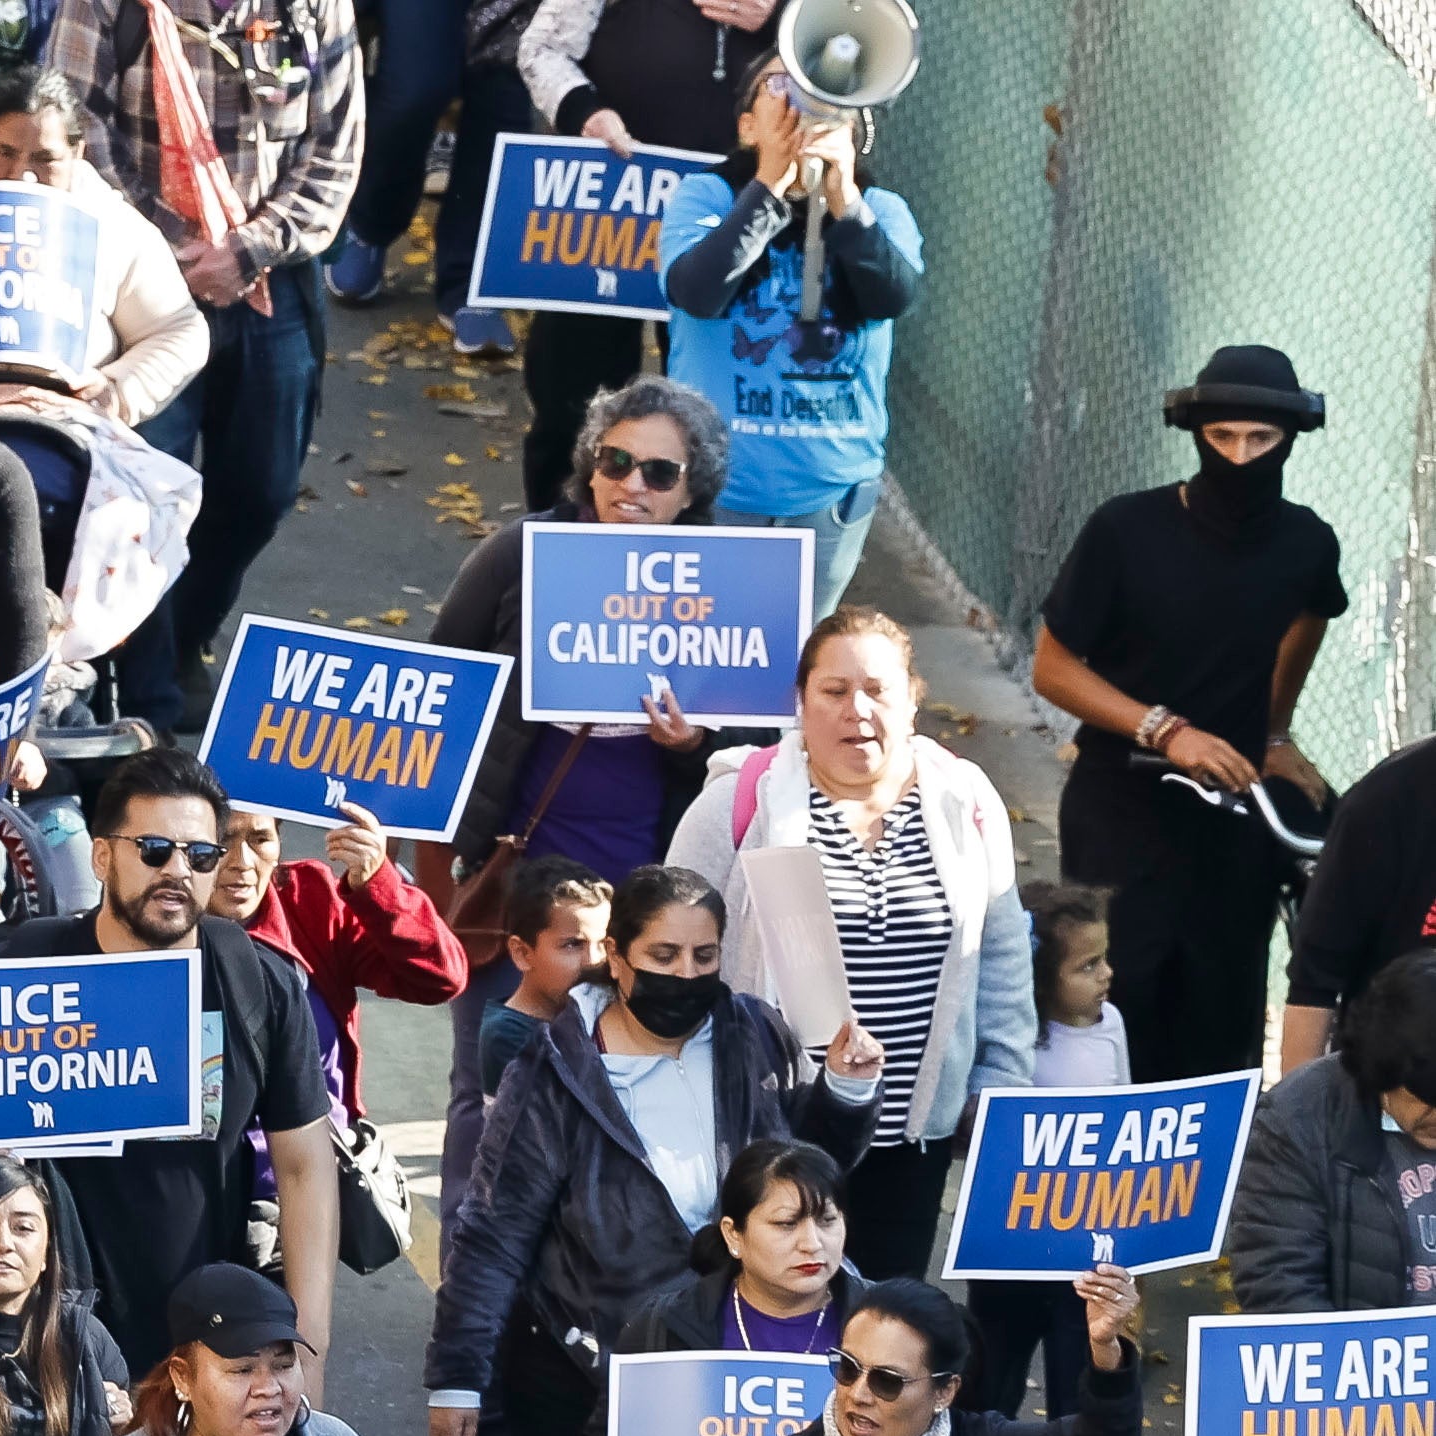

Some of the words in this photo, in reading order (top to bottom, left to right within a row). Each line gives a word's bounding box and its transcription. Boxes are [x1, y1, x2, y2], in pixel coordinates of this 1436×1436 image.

[534, 158, 607, 210] WE
[610, 164, 680, 216] AR
[521, 210, 663, 272] HUMA
[625, 550, 701, 594] ICE
[602, 594, 664, 622] OUT
[673, 595, 714, 622] OF
[547, 620, 770, 668] CALIFORNIA
[271, 644, 348, 713] WE
[352, 661, 455, 728] ARE
[247, 705, 446, 790] HUMAN
[55, 1022, 98, 1053] OF
[1021, 1110, 1103, 1168] WE
[1106, 1101, 1206, 1167] ARE
[1005, 1158, 1202, 1234] HUMAN
[723, 1375, 805, 1418] ICE
[1238, 1337, 1325, 1404] WE
[1334, 1337, 1430, 1399] ARE
